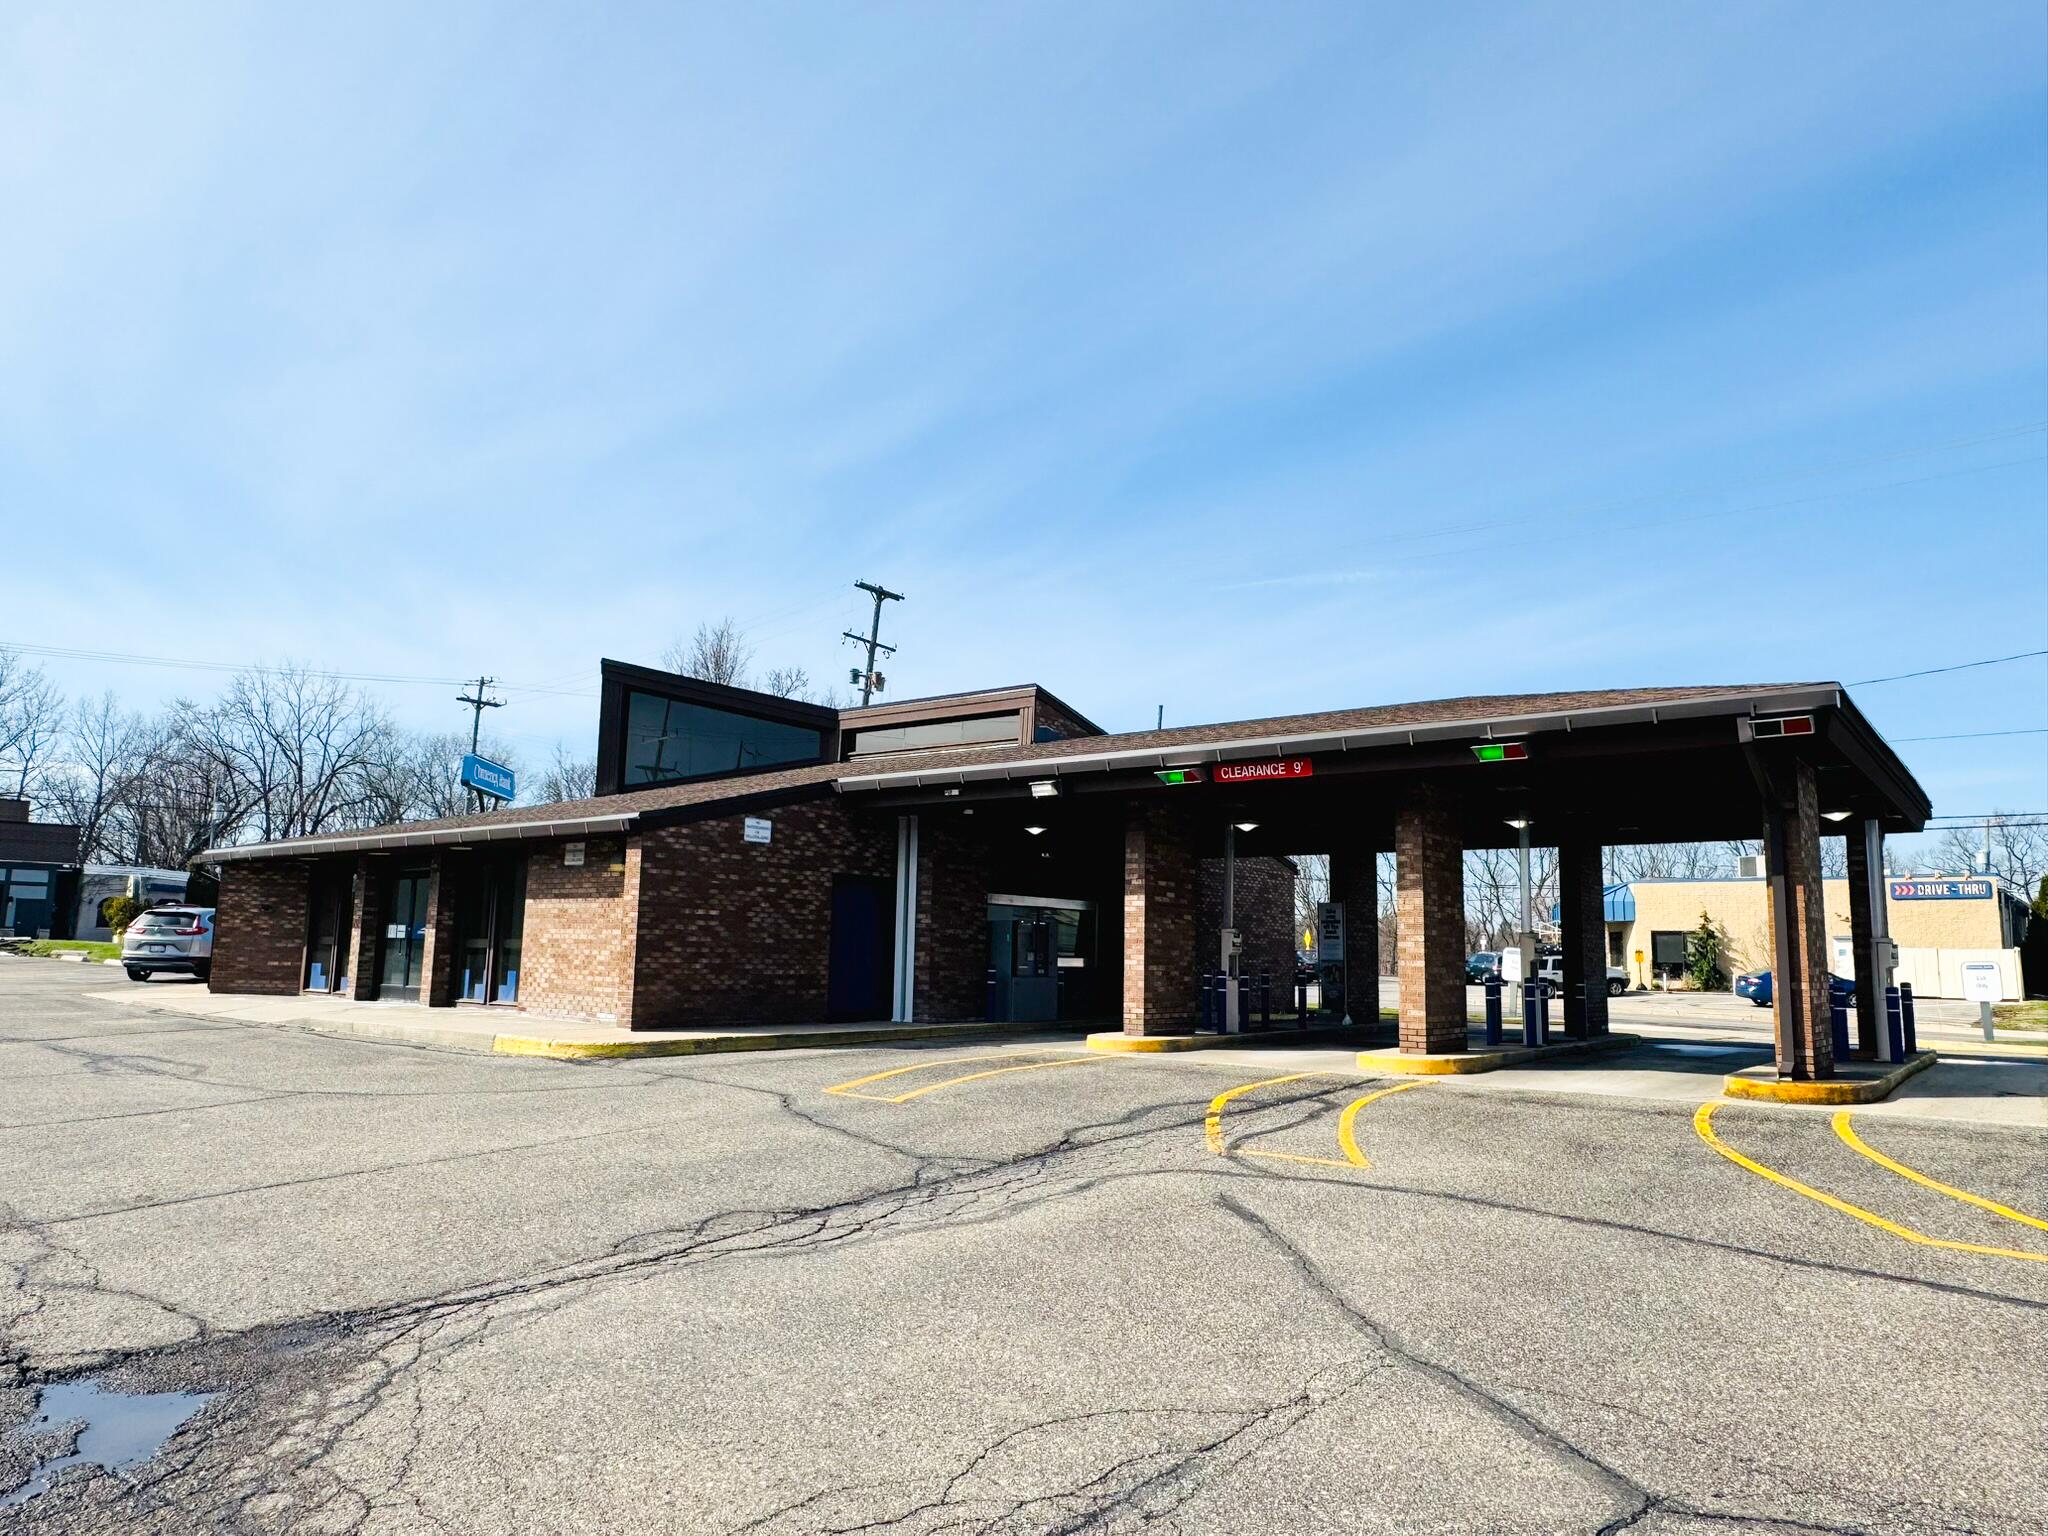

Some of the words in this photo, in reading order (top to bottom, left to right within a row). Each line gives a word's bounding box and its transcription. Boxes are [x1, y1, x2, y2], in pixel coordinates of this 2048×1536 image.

[1221, 763, 1286, 779] CLEARANCE
[1293, 761, 1304, 774] 9'
[1917, 883, 1987, 896] DRIVE-THRU
